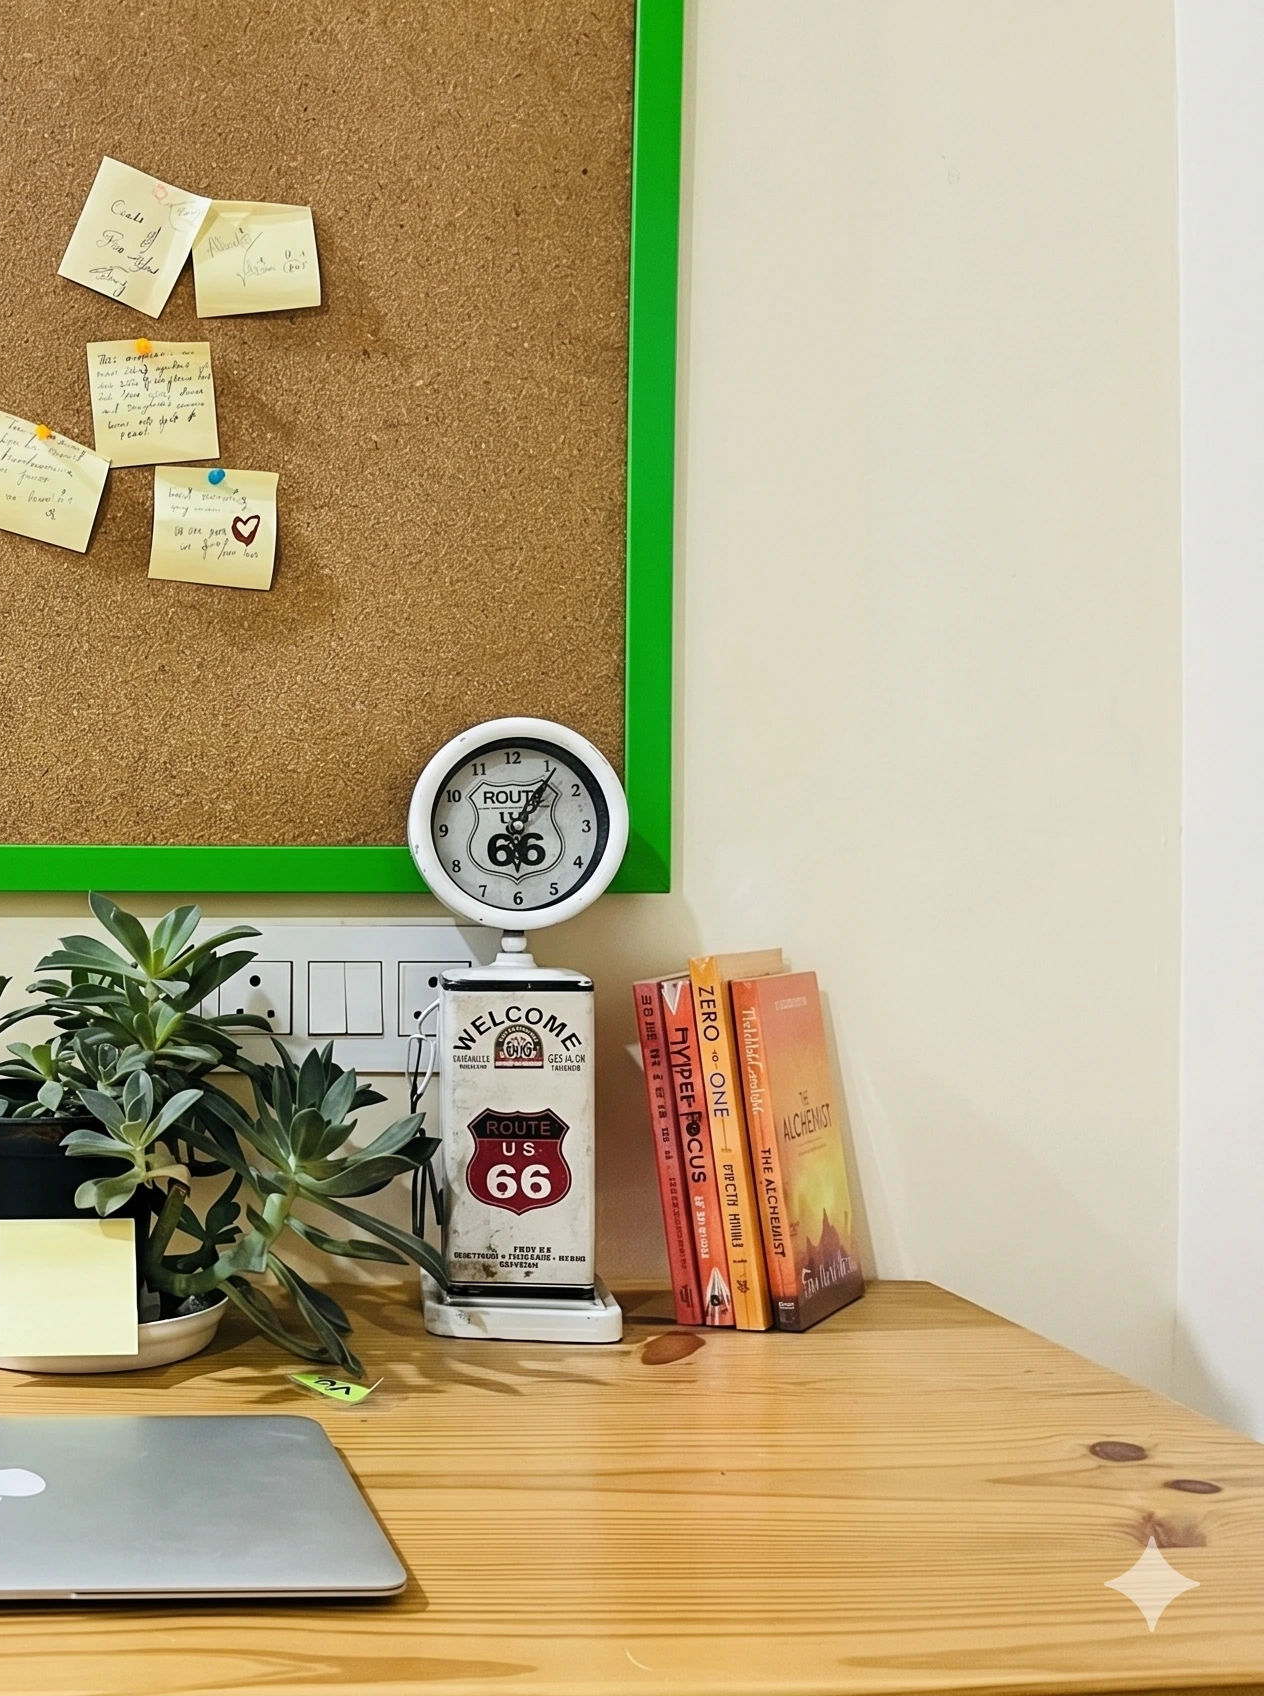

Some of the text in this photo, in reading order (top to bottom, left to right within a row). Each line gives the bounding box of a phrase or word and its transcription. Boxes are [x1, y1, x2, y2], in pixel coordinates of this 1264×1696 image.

[504, 751, 522, 765] 12
[471, 763, 487, 777] 11
[543, 760, 551, 773] 1
[446, 789, 462, 804] 10
[483, 790, 539, 805] ROUT
[570, 784, 582, 798] 2
[439, 824, 449, 838] 9
[581, 820, 592, 833] 3
[487, 832, 546, 867] 66
[452, 859, 462, 873] 8
[573, 856, 584, 869] 4
[478, 884, 488, 898] 7
[549, 882, 559, 896] 5
[512, 891, 524, 906] 6
[452, 1005, 583, 1052] WELCOME
[698, 986, 720, 1042] ZERO
[710, 1072, 730, 1118] ONE
[486, 1120, 551, 1136] ROUTE
[783, 1103, 832, 1142] ALCHEMIST
[761, 1148, 773, 1174] THE
[486, 1163, 552, 1200] 66
